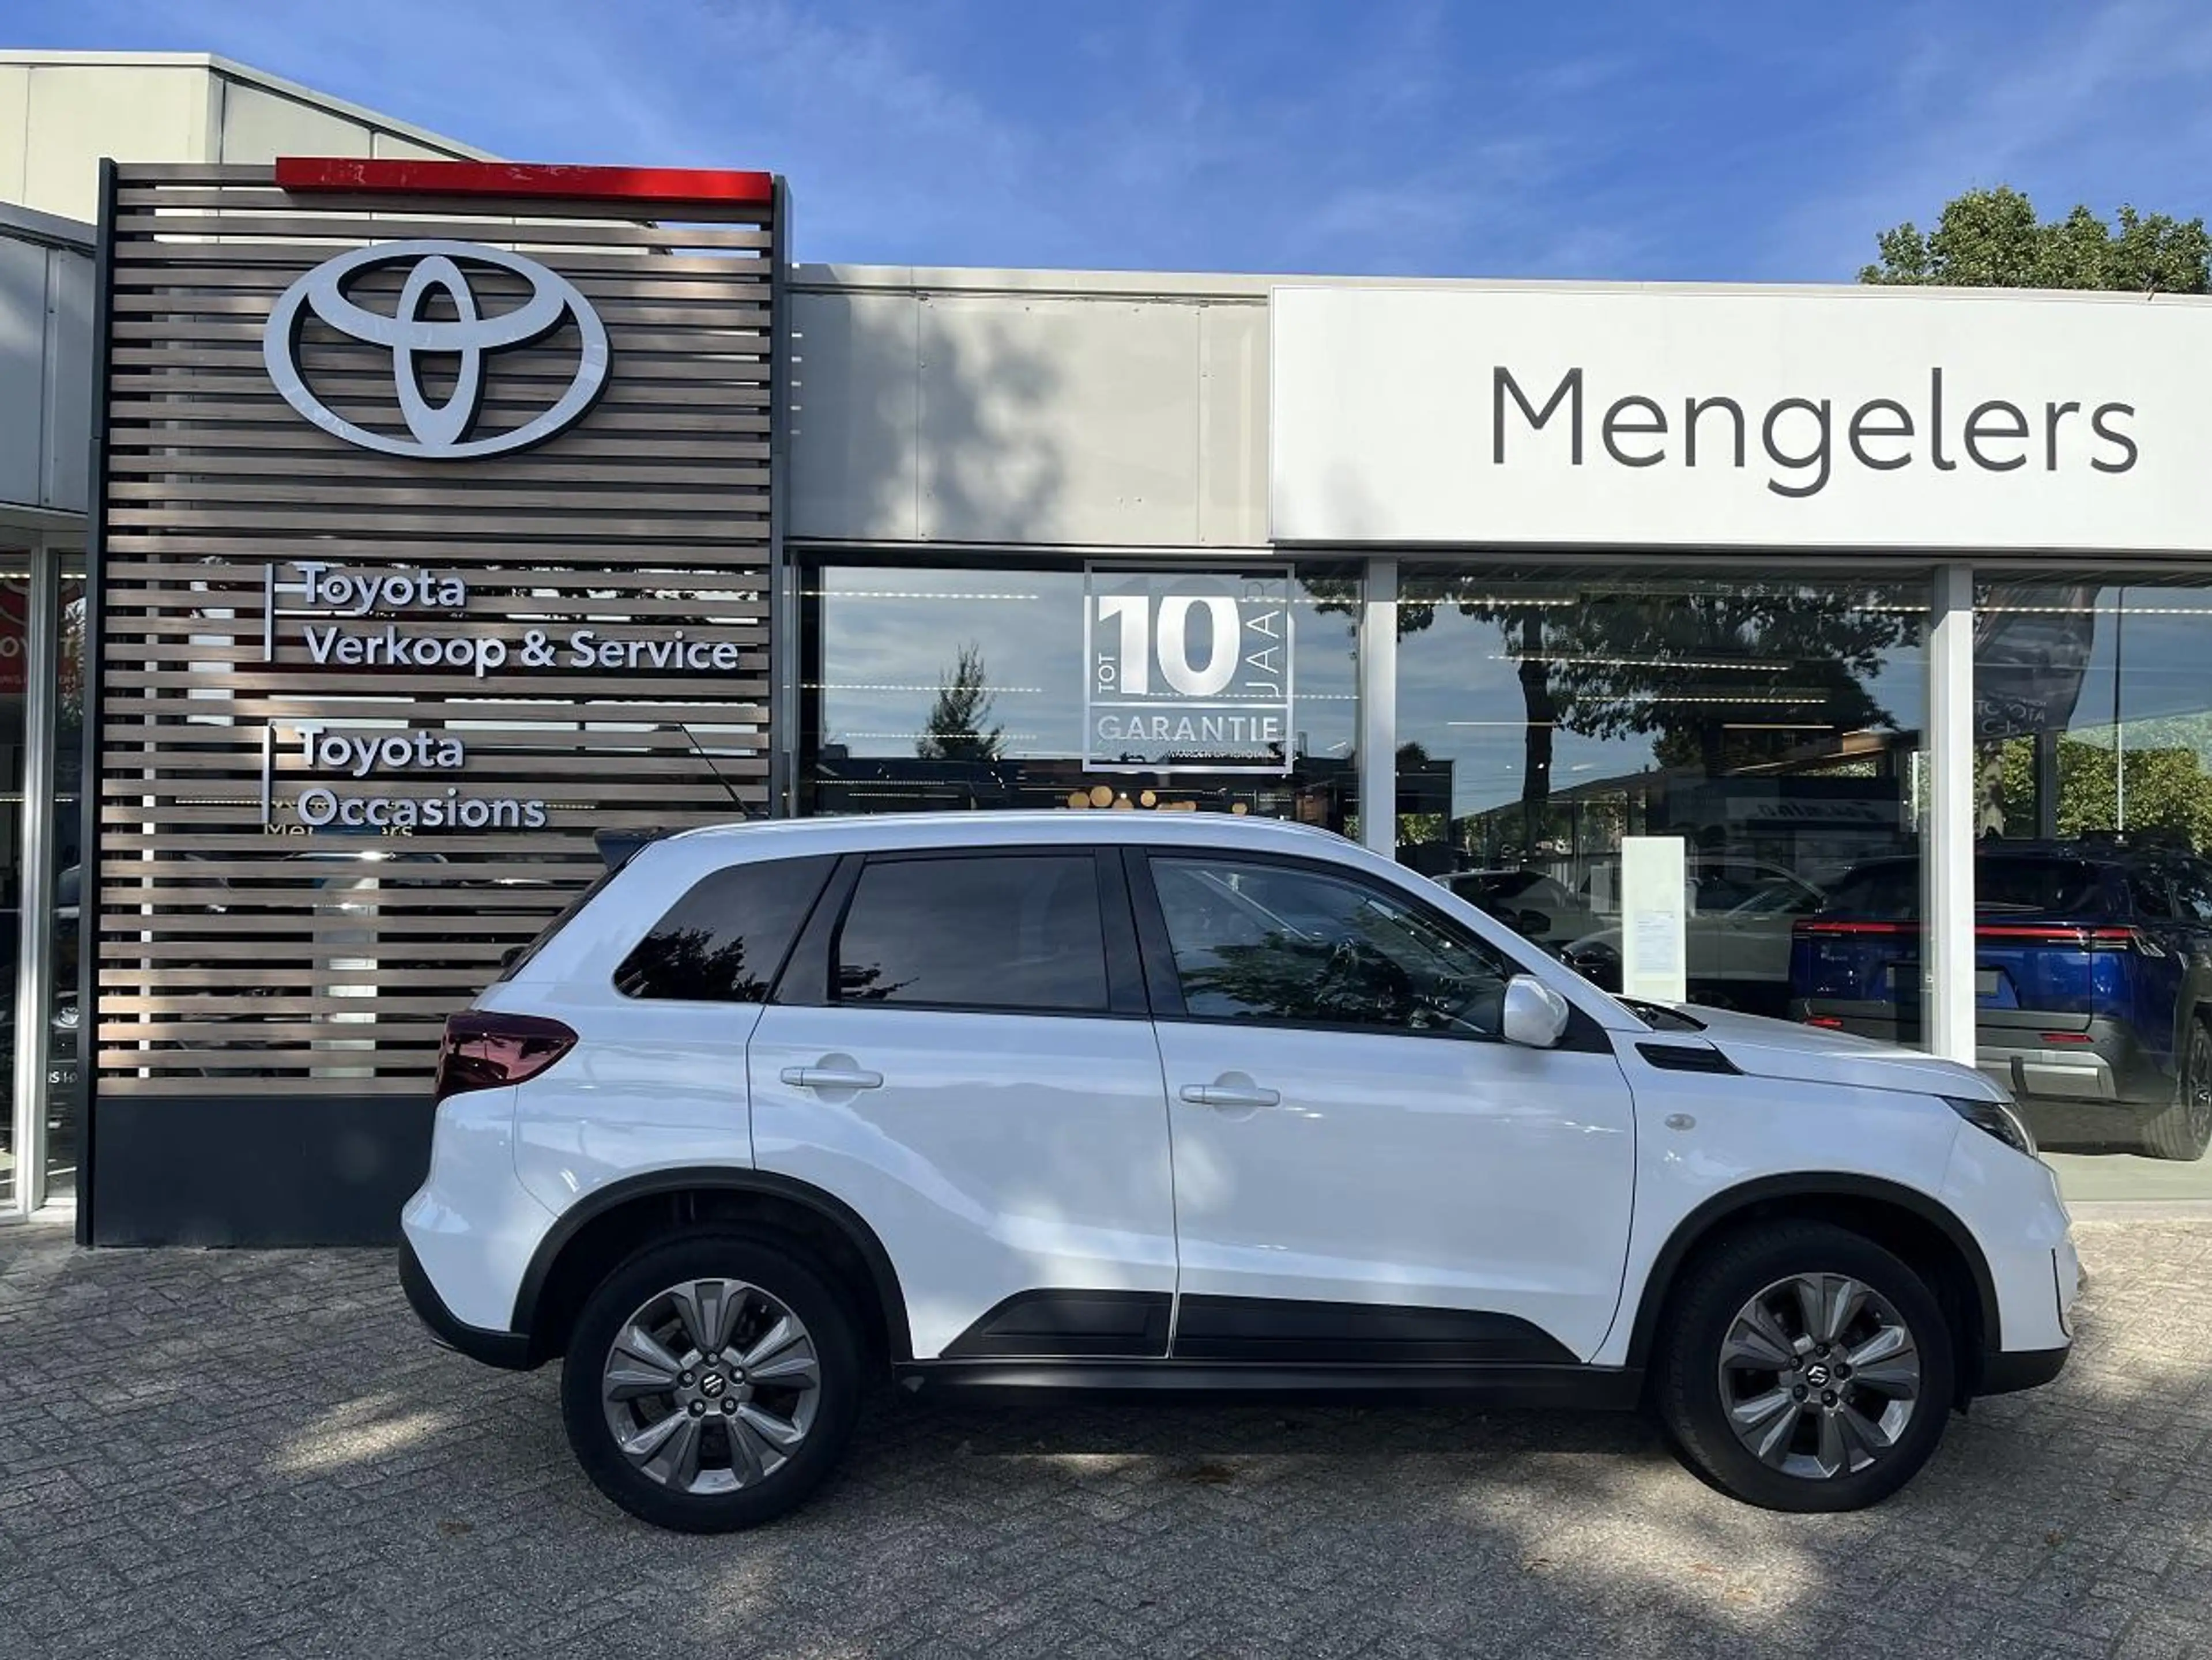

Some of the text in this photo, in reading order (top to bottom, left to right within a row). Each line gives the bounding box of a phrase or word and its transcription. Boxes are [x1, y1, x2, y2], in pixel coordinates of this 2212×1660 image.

[1493, 365, 2139, 498] Mengelers
[296, 561, 465, 615] Toyota
[303, 625, 738, 677] Verkoop & Service
[1098, 578, 1240, 696] 10
[1245, 579, 1280, 697] JAAR
[1098, 652, 1116, 694] TOT
[295, 727, 463, 777] Toyota
[1097, 715, 1279, 742] GARANTIE
[297, 787, 547, 827] Occasions
